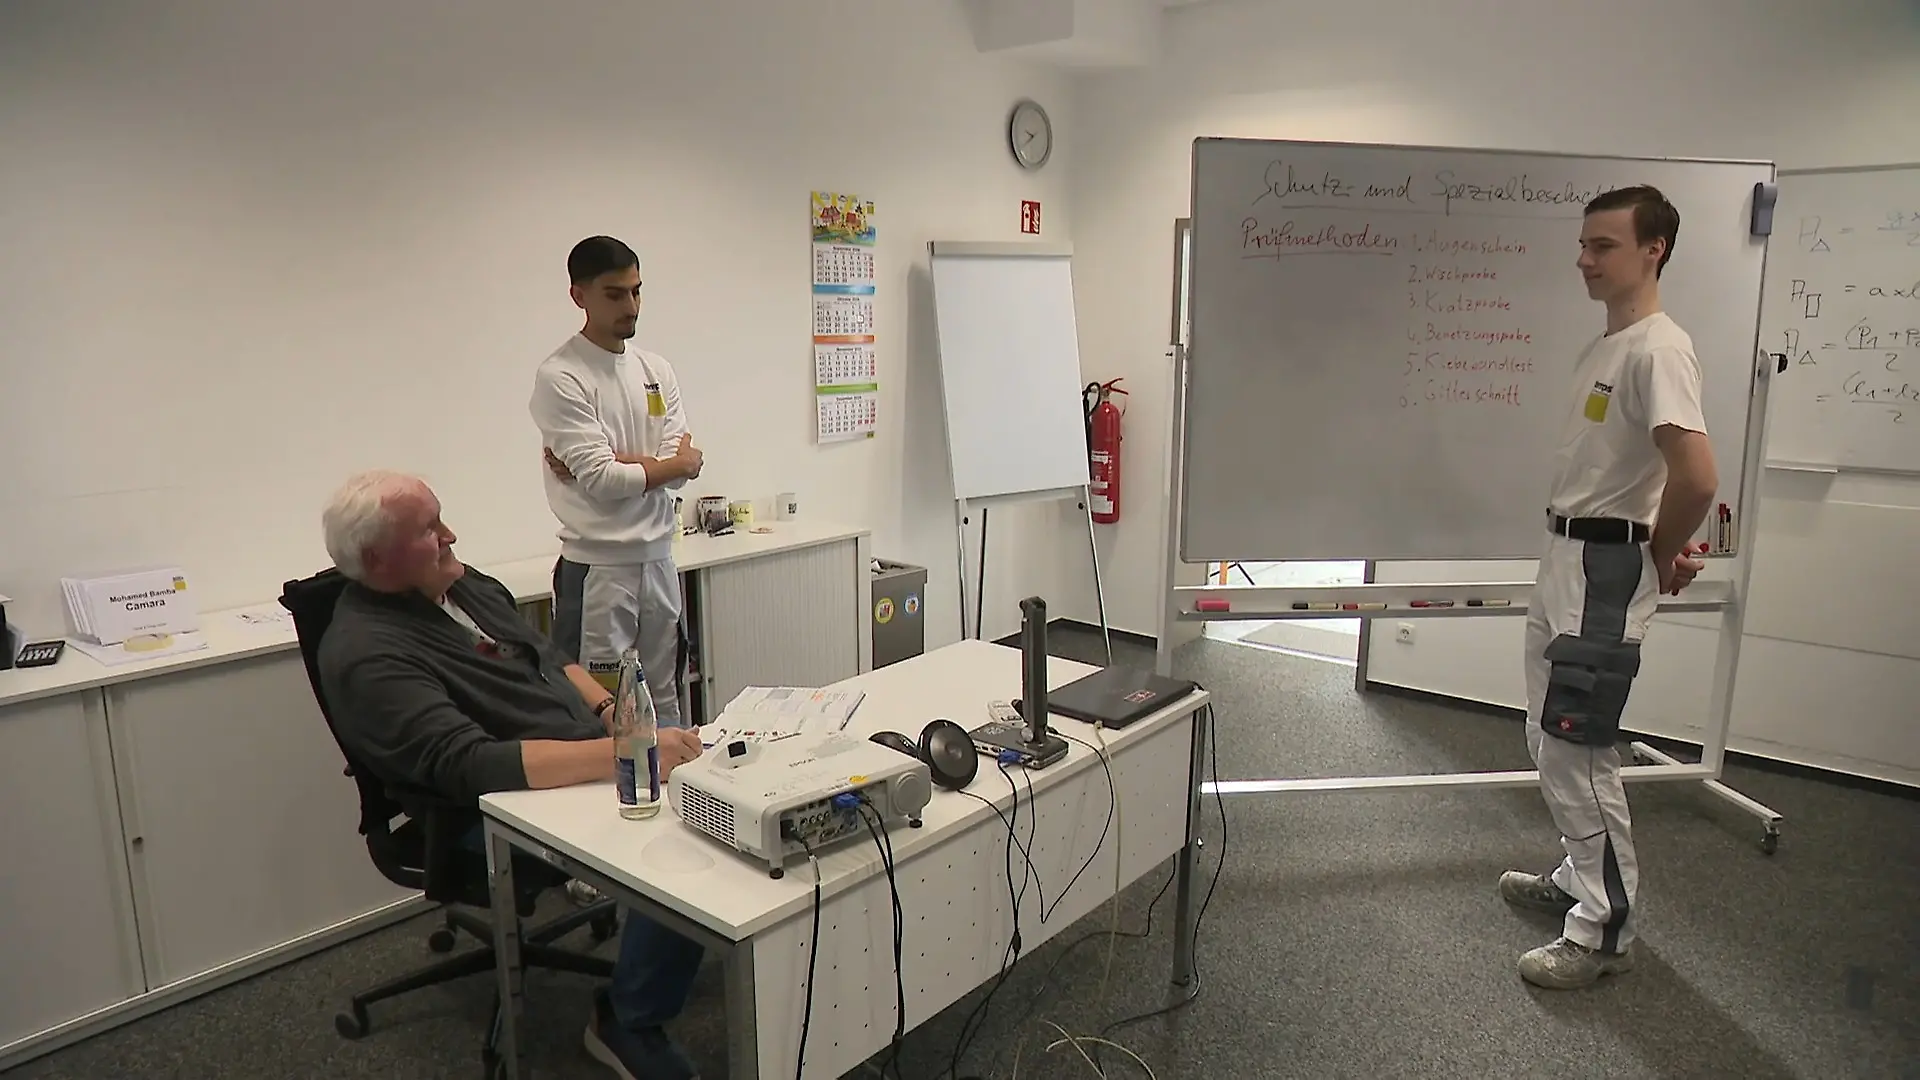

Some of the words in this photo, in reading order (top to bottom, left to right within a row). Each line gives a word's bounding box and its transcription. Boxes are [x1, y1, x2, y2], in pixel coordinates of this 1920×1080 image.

[1364, 175, 1415, 204] und
[1431, 170, 1615, 216] Spezialbeschic
[1242, 217, 1397, 262] Prüfmethoden
[109, 591, 148, 603] Mohamed
[149, 588, 176, 598] Bamba
[125, 599, 166, 612] Camara
